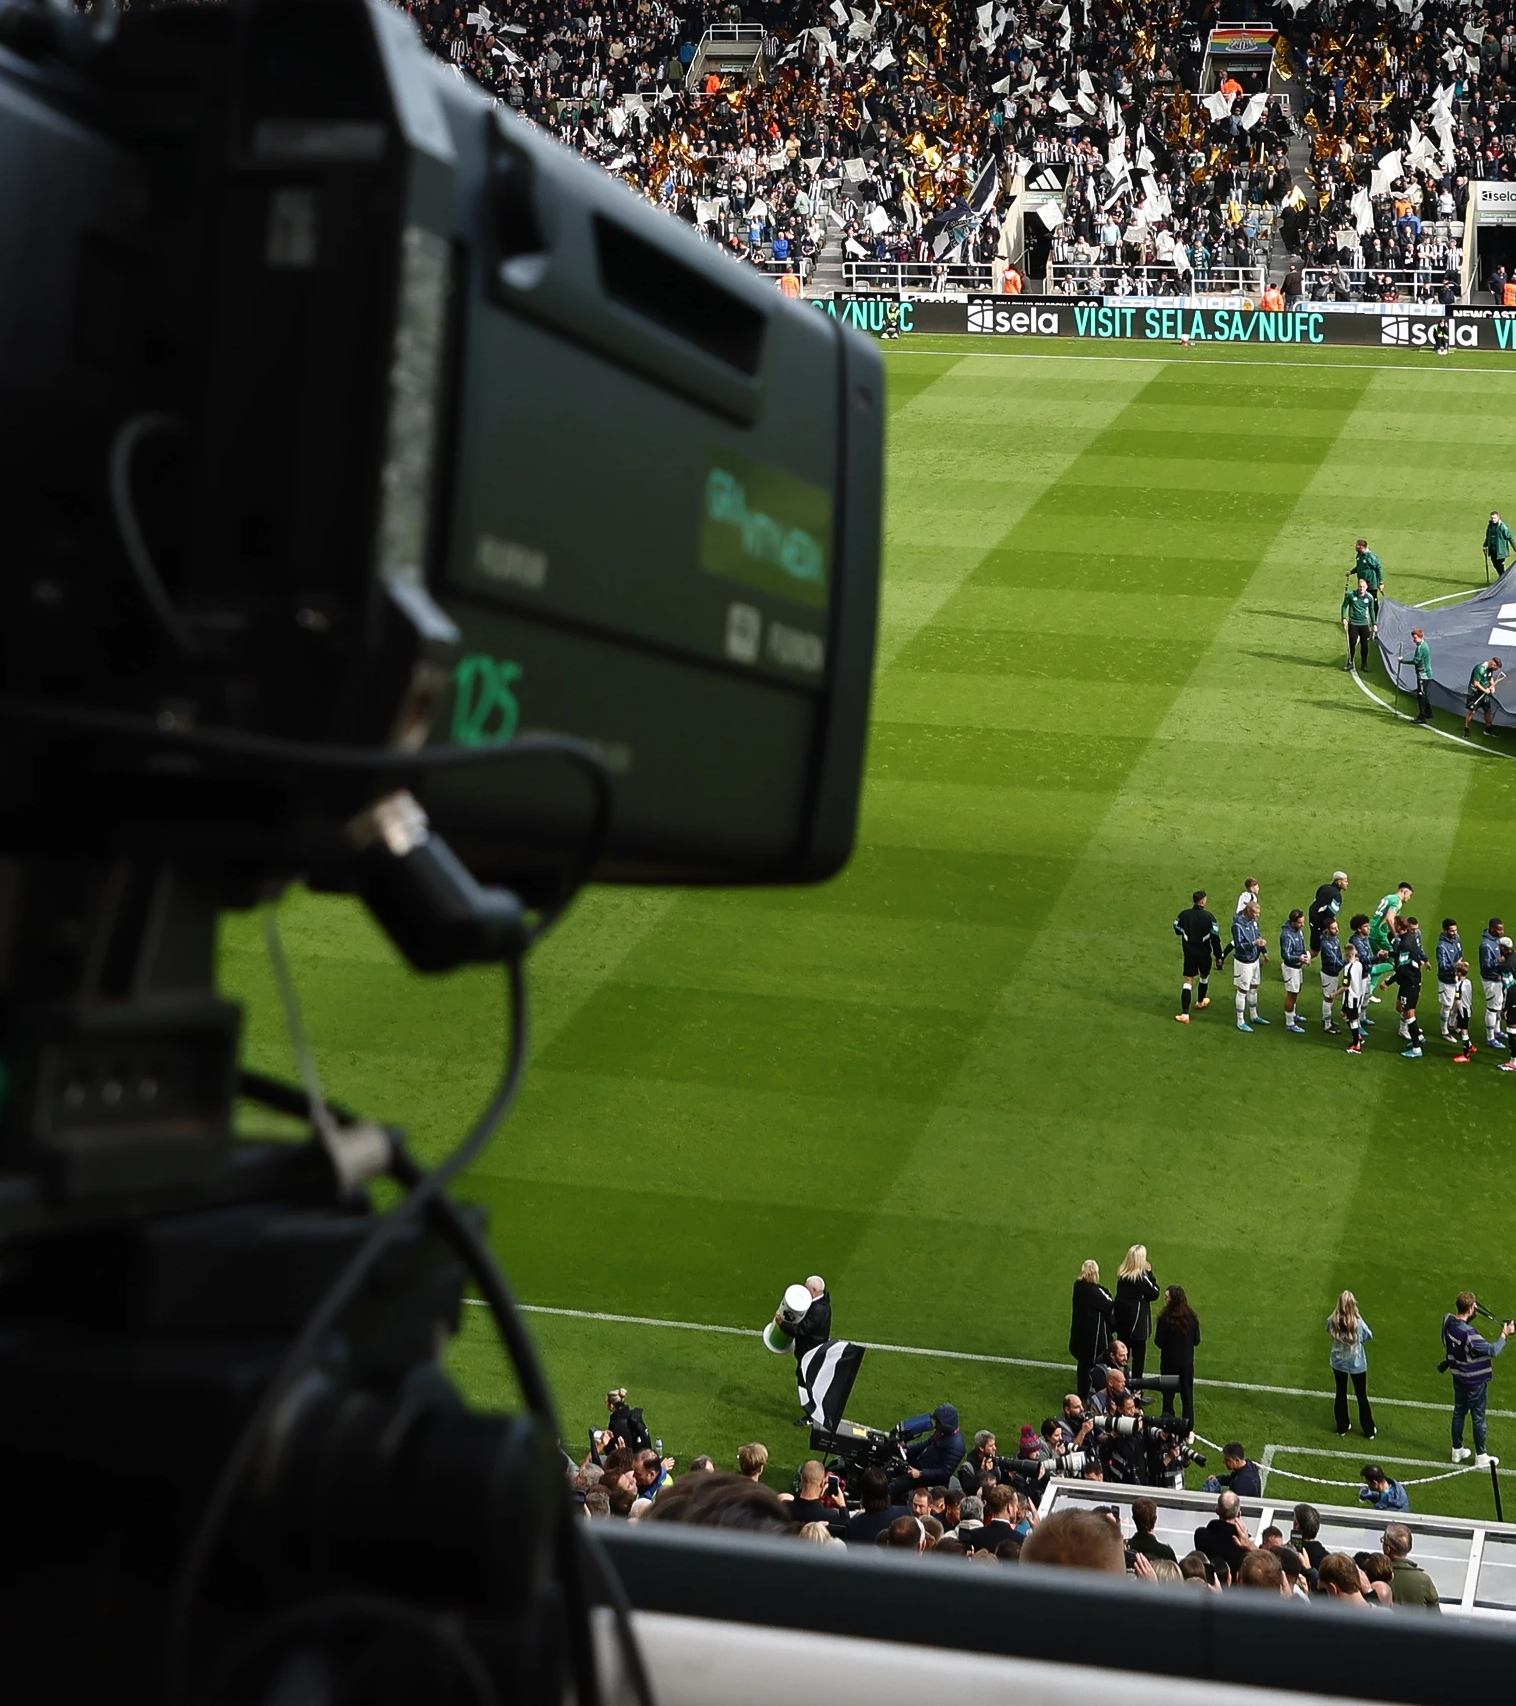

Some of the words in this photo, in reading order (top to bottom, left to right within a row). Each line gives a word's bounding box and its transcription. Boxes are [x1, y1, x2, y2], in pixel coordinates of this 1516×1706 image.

[995, 307, 1059, 334] sela
[1074, 307, 1136, 338] VISIT
[1145, 308, 1324, 343] SELA.SA/NUFC
